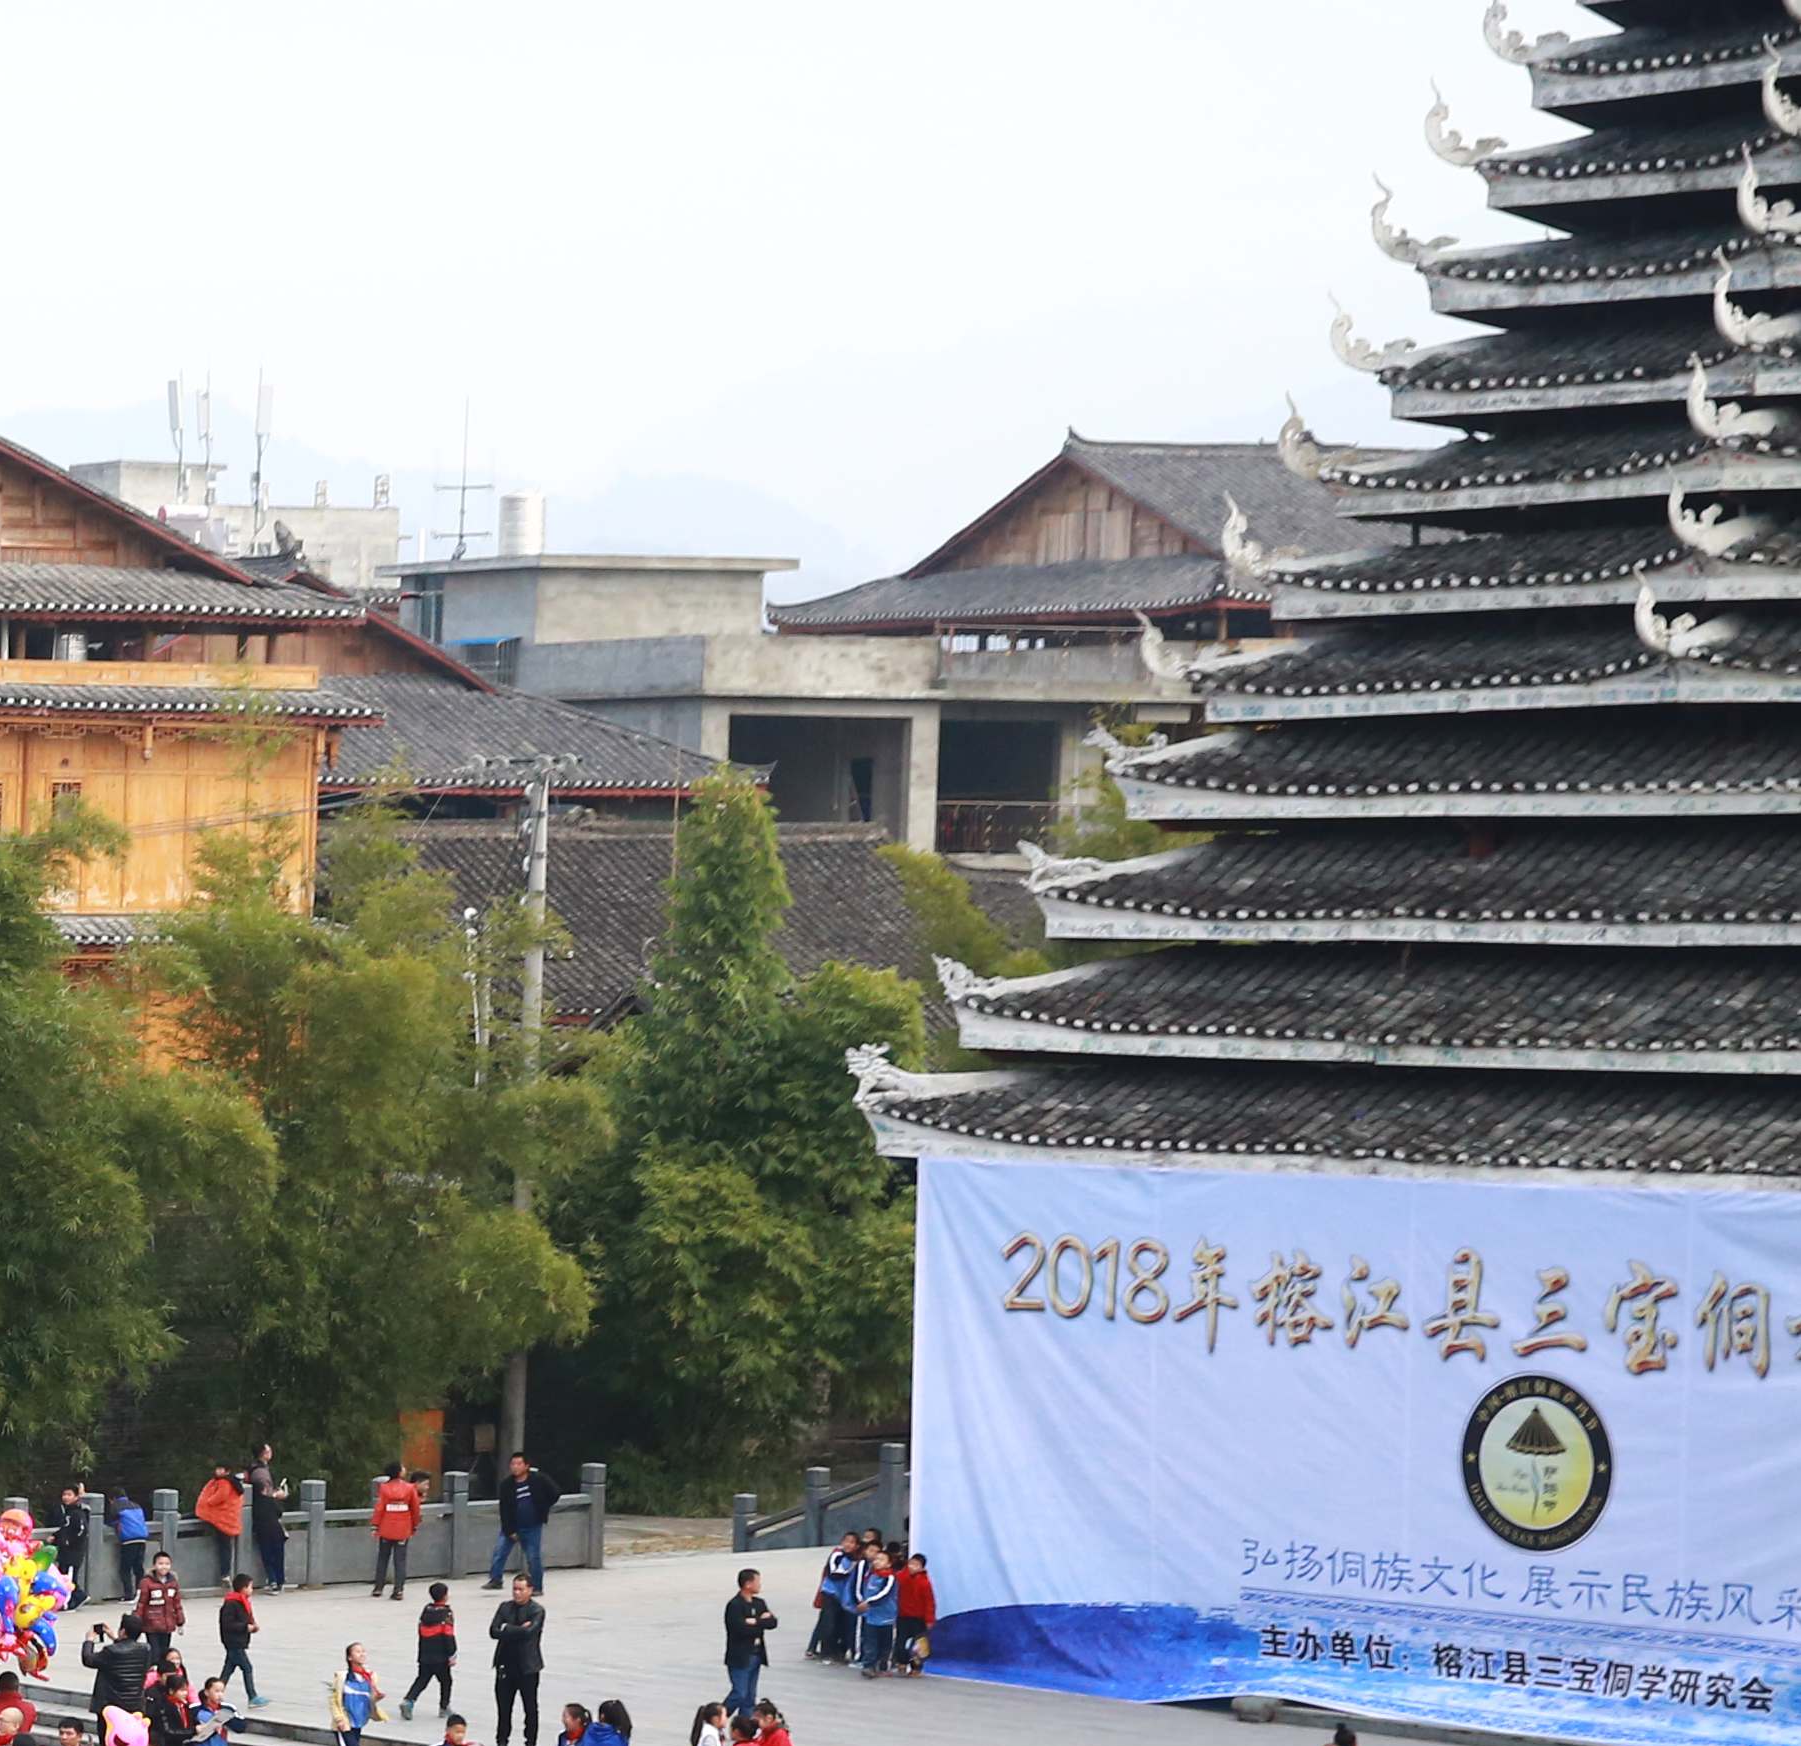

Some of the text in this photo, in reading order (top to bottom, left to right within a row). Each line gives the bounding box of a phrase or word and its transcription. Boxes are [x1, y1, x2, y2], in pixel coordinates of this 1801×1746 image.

[1001, 1230, 1801, 1379] 2018年榕江县三宝侗
[1241, 1538, 1801, 1631] 弘扬侗族文化 展示民族风采
